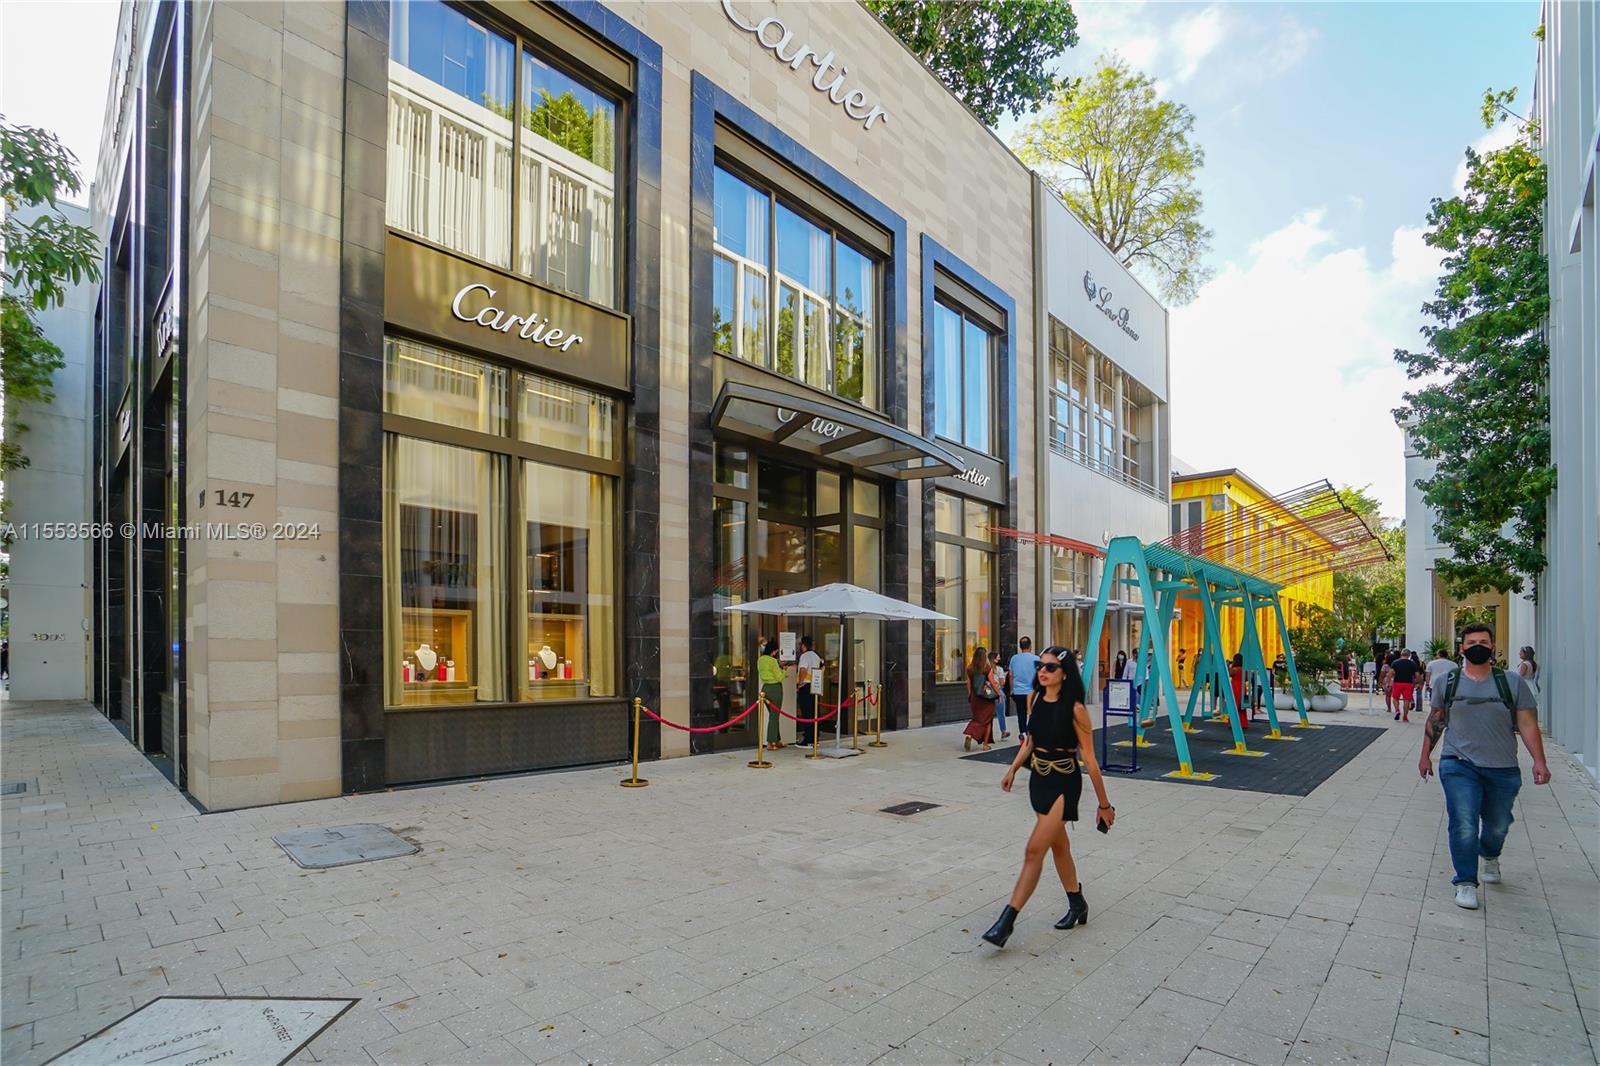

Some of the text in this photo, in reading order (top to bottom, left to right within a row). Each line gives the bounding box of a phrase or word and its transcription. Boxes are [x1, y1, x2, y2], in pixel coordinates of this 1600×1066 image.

[452, 283, 583, 352] Cartier
[215, 489, 255, 508] 147
[171, 1025, 222, 1044] PASEO
